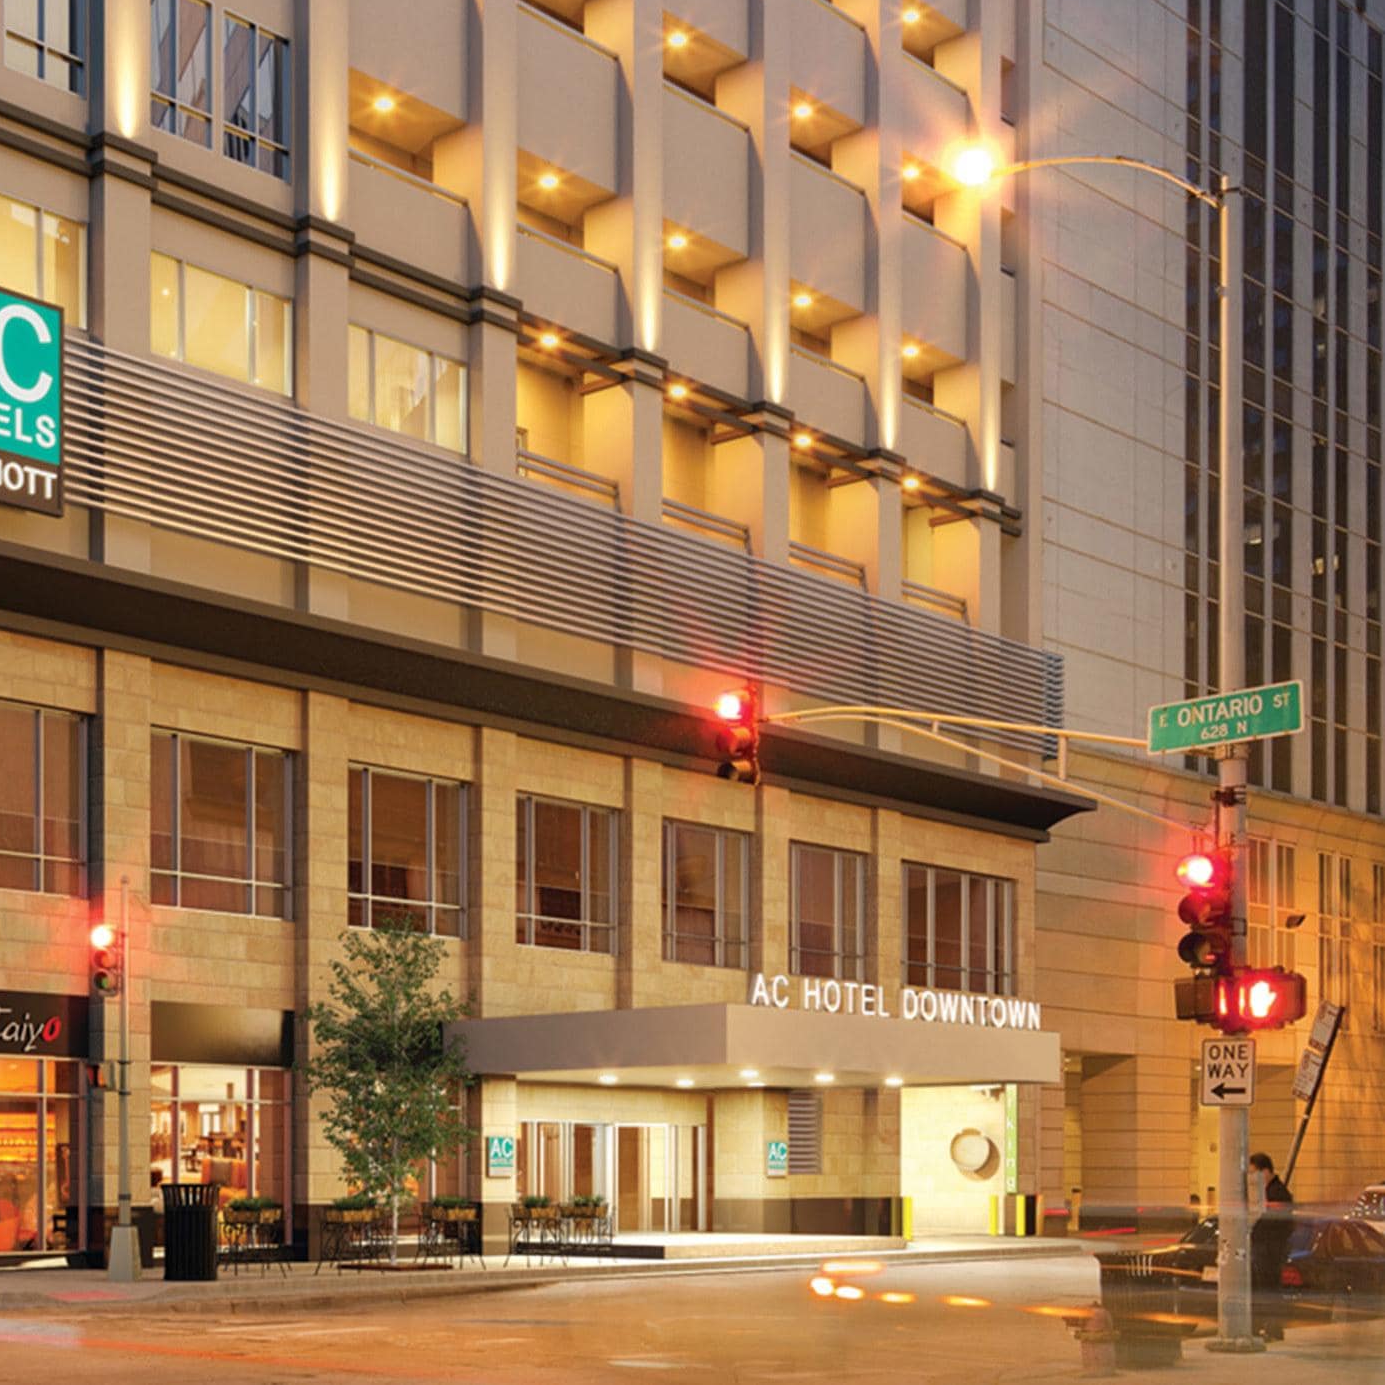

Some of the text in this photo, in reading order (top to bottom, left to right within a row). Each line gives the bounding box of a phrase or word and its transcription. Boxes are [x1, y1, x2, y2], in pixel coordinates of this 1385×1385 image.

[1159, 693, 1290, 727] E ONTARIO ST
[1200, 721, 1247, 740] 628 N
[751, 973, 1041, 1030] AC HOTEL DOWNTOWN
[1208, 1044, 1249, 1060] ONE
[1207, 1063, 1249, 1078] WAY
[489, 1138, 514, 1159] AC
[768, 1142, 787, 1160] AC
